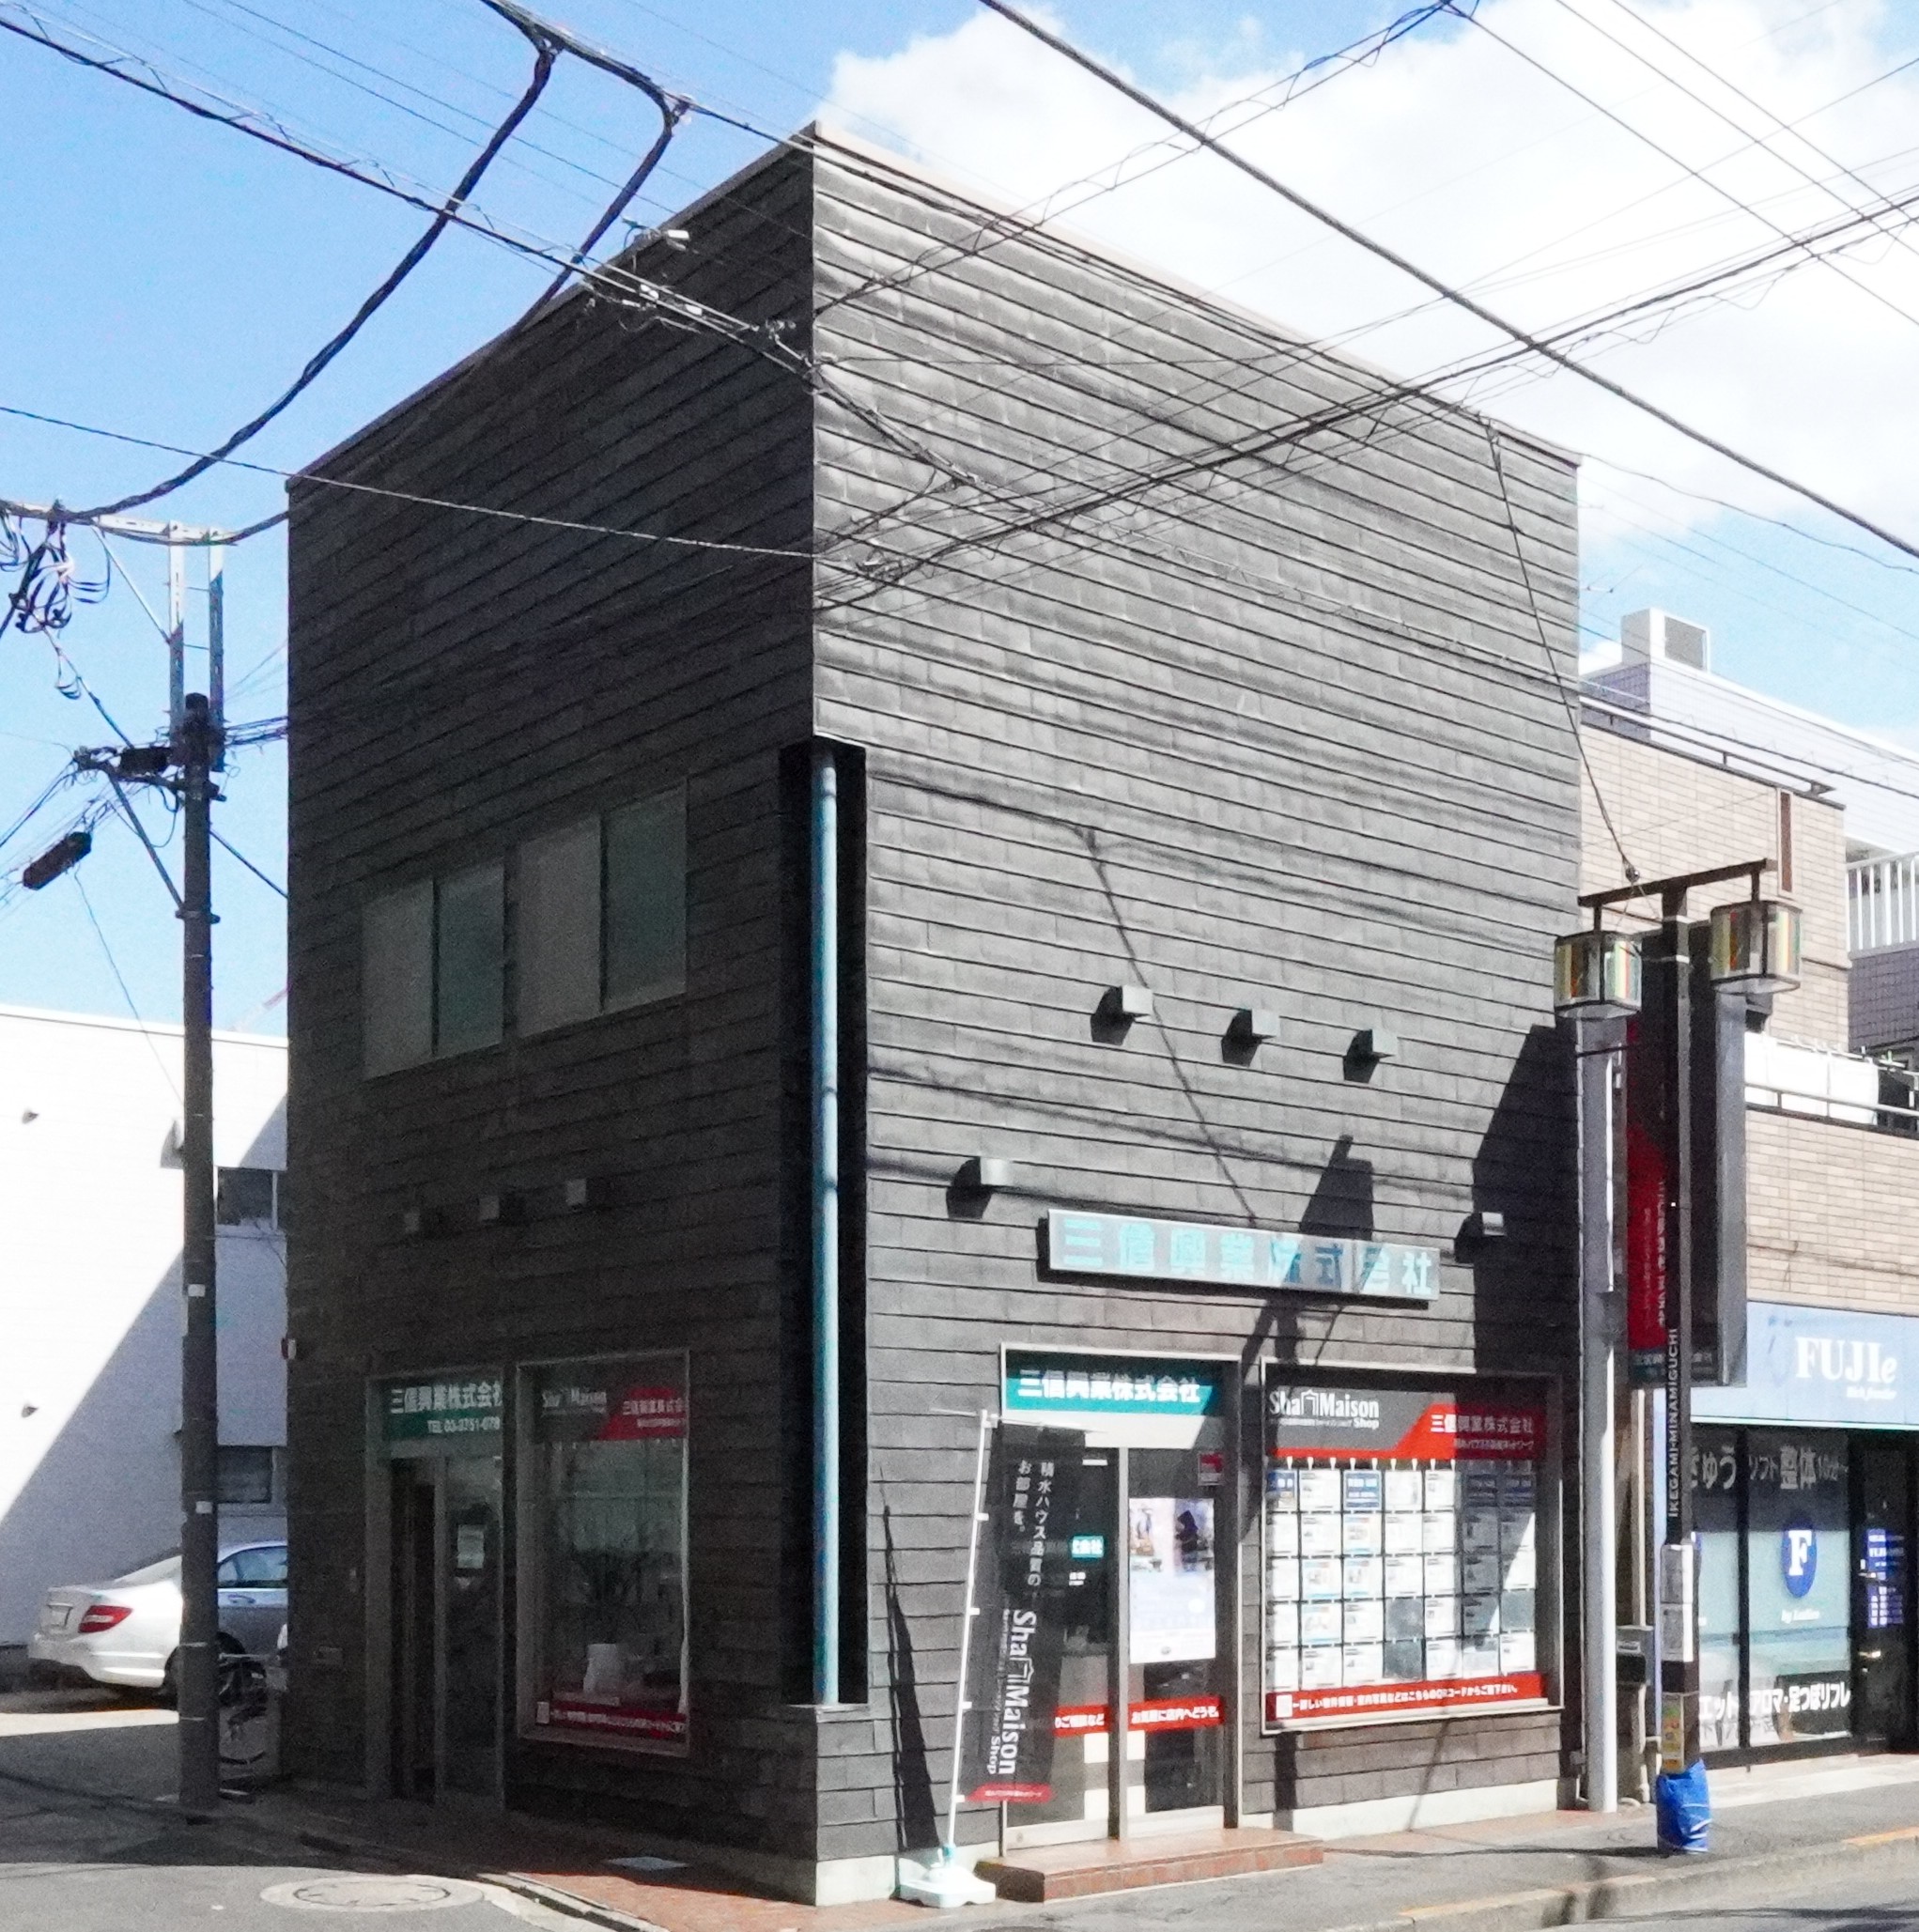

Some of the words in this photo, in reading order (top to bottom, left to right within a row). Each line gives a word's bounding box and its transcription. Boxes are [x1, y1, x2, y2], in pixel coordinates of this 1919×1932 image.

[1795, 1336, 1897, 1384] FUJIe
[1353, 1418, 1380, 1430] Shop
[1788, 1529, 1813, 1576] F
